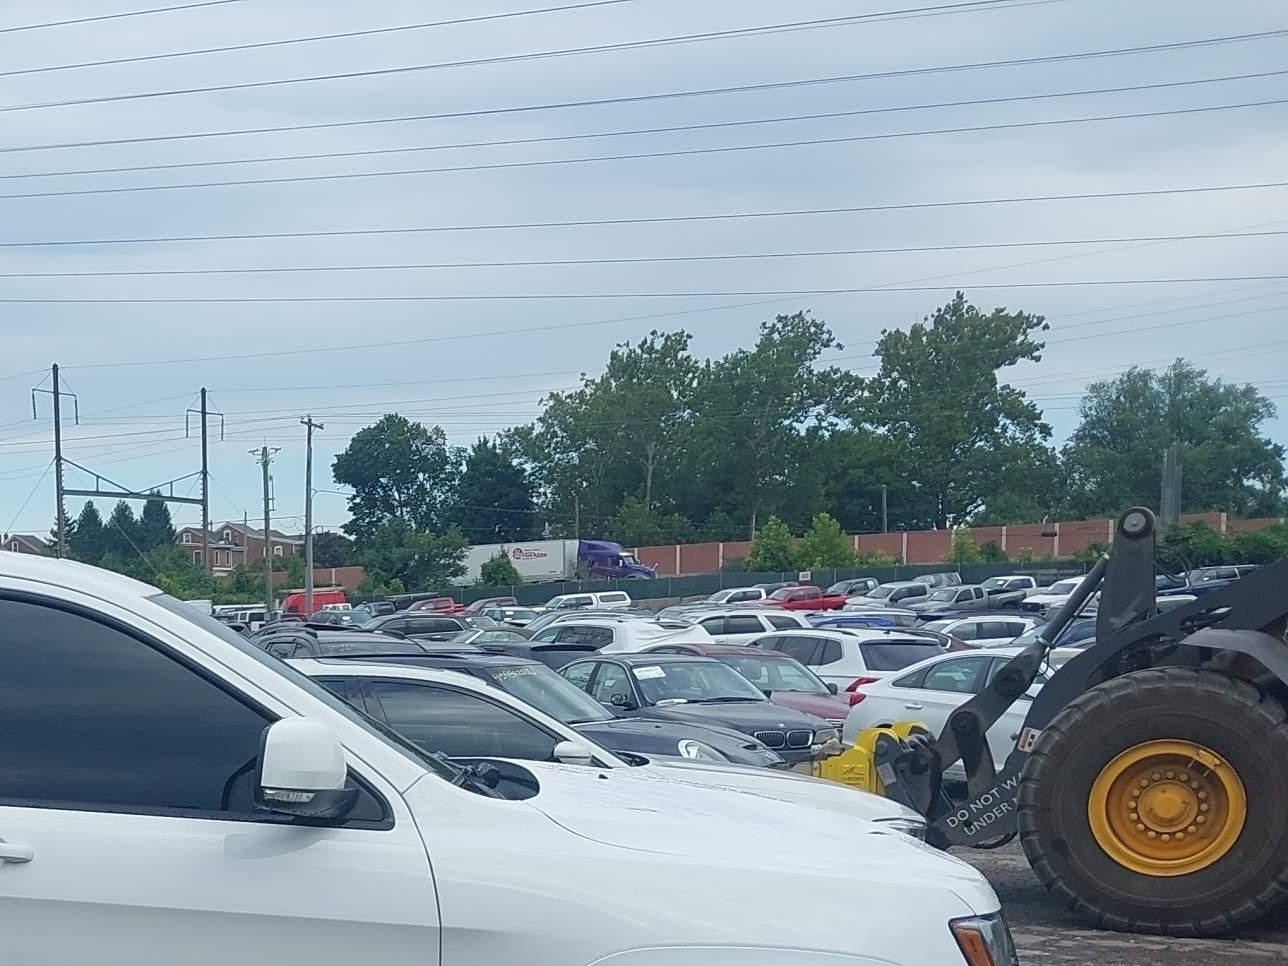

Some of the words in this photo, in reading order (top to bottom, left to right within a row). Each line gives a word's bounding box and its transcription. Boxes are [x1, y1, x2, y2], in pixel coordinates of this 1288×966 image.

[946, 809, 969, 828] DO
[969, 787, 1001, 813] NOT
[1001, 772, 1022, 790] W
[963, 802, 1012, 836] UNDER
